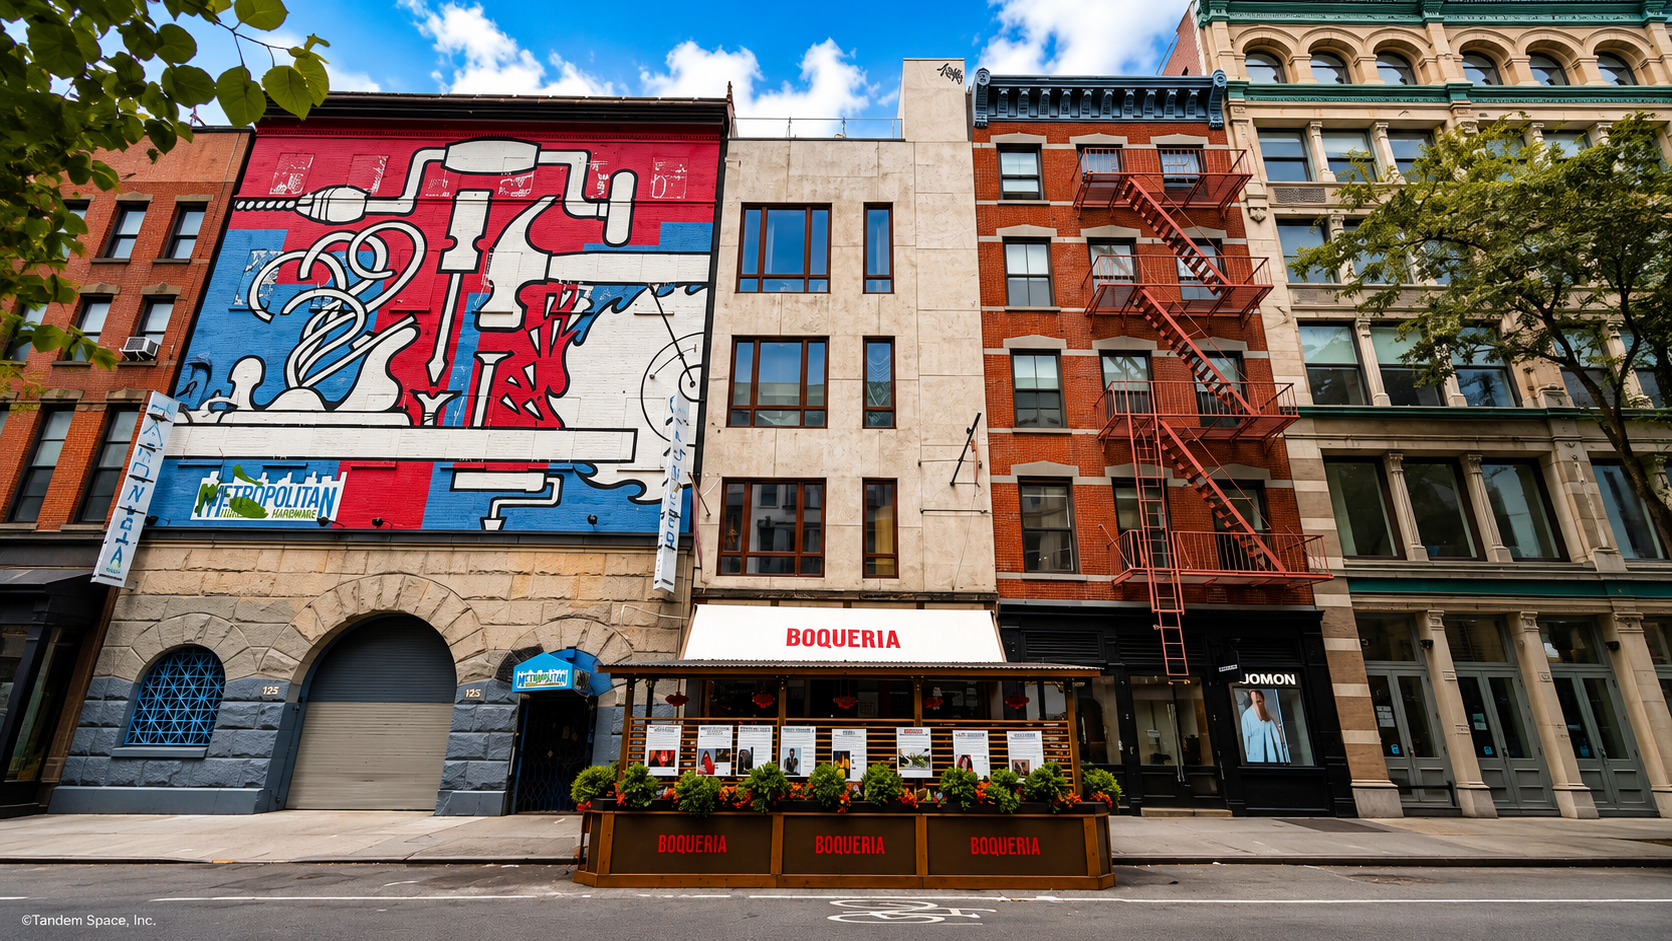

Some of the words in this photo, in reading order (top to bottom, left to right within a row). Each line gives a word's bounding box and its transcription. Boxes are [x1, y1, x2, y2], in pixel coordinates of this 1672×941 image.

[786, 628, 901, 648] BOQUERIA
[262, 686, 279, 695] 125
[465, 688, 482, 698] 125
[657, 834, 728, 854] BOQUERIA
[815, 835, 886, 855] BOQUERIA
[970, 836, 1041, 857] BOQUERIA
